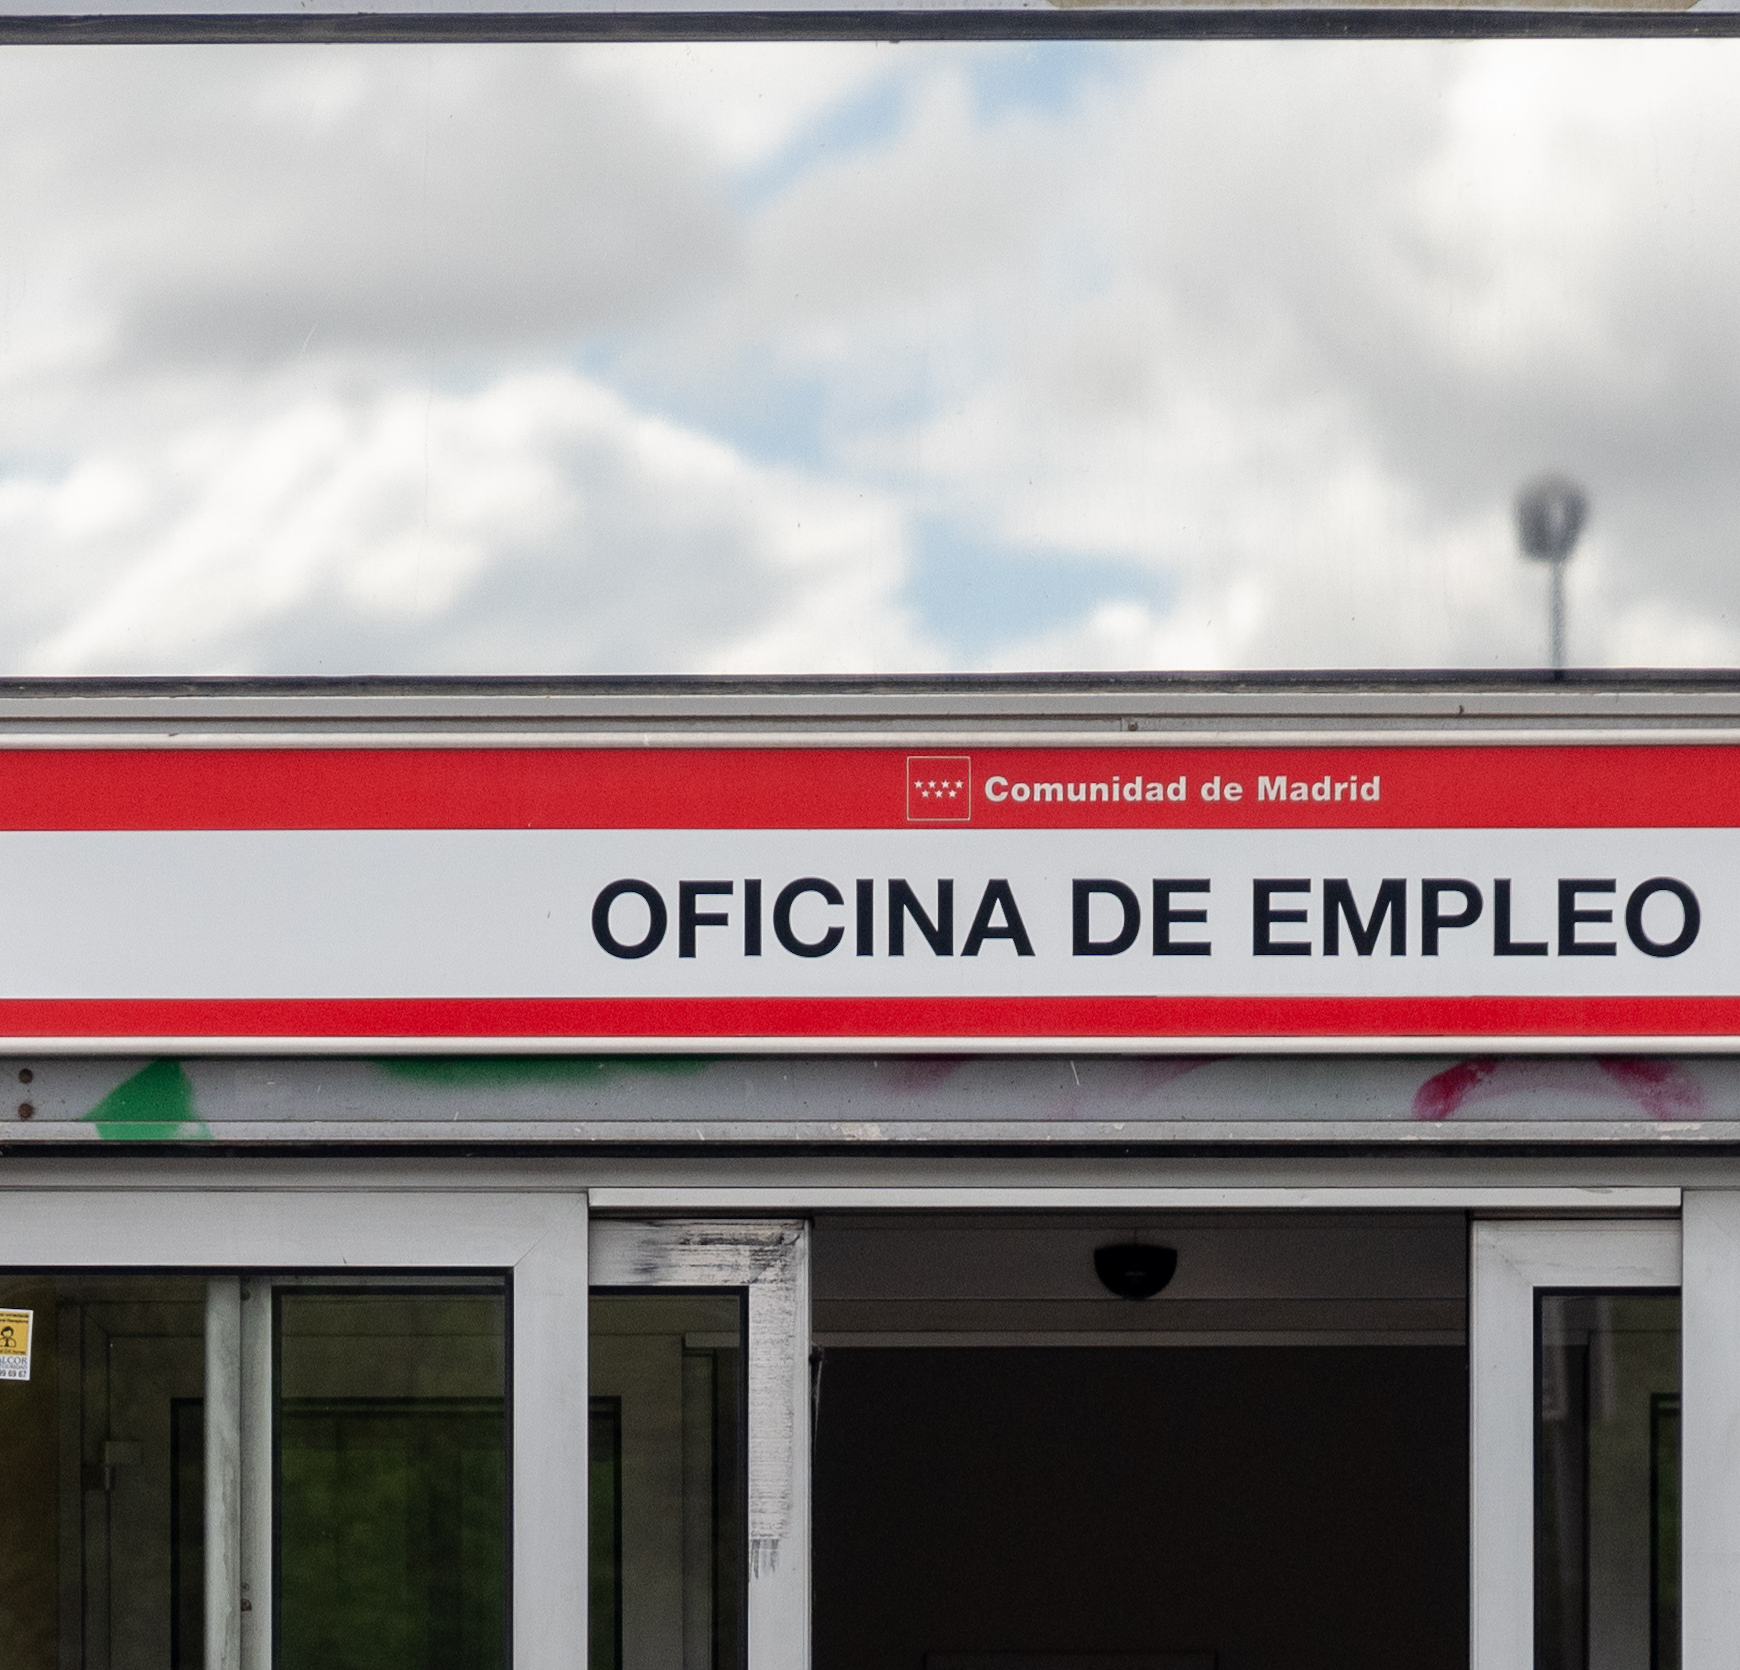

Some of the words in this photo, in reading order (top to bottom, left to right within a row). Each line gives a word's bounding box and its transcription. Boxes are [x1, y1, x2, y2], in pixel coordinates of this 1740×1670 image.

[984, 775, 1187, 803] Comunidad
[1200, 775, 1244, 803] de
[1257, 775, 1381, 803] Madrid
[591, 877, 1036, 960] OFICINA
[1072, 878, 1212, 957] DE
[1252, 877, 1701, 959] EMPLEO
